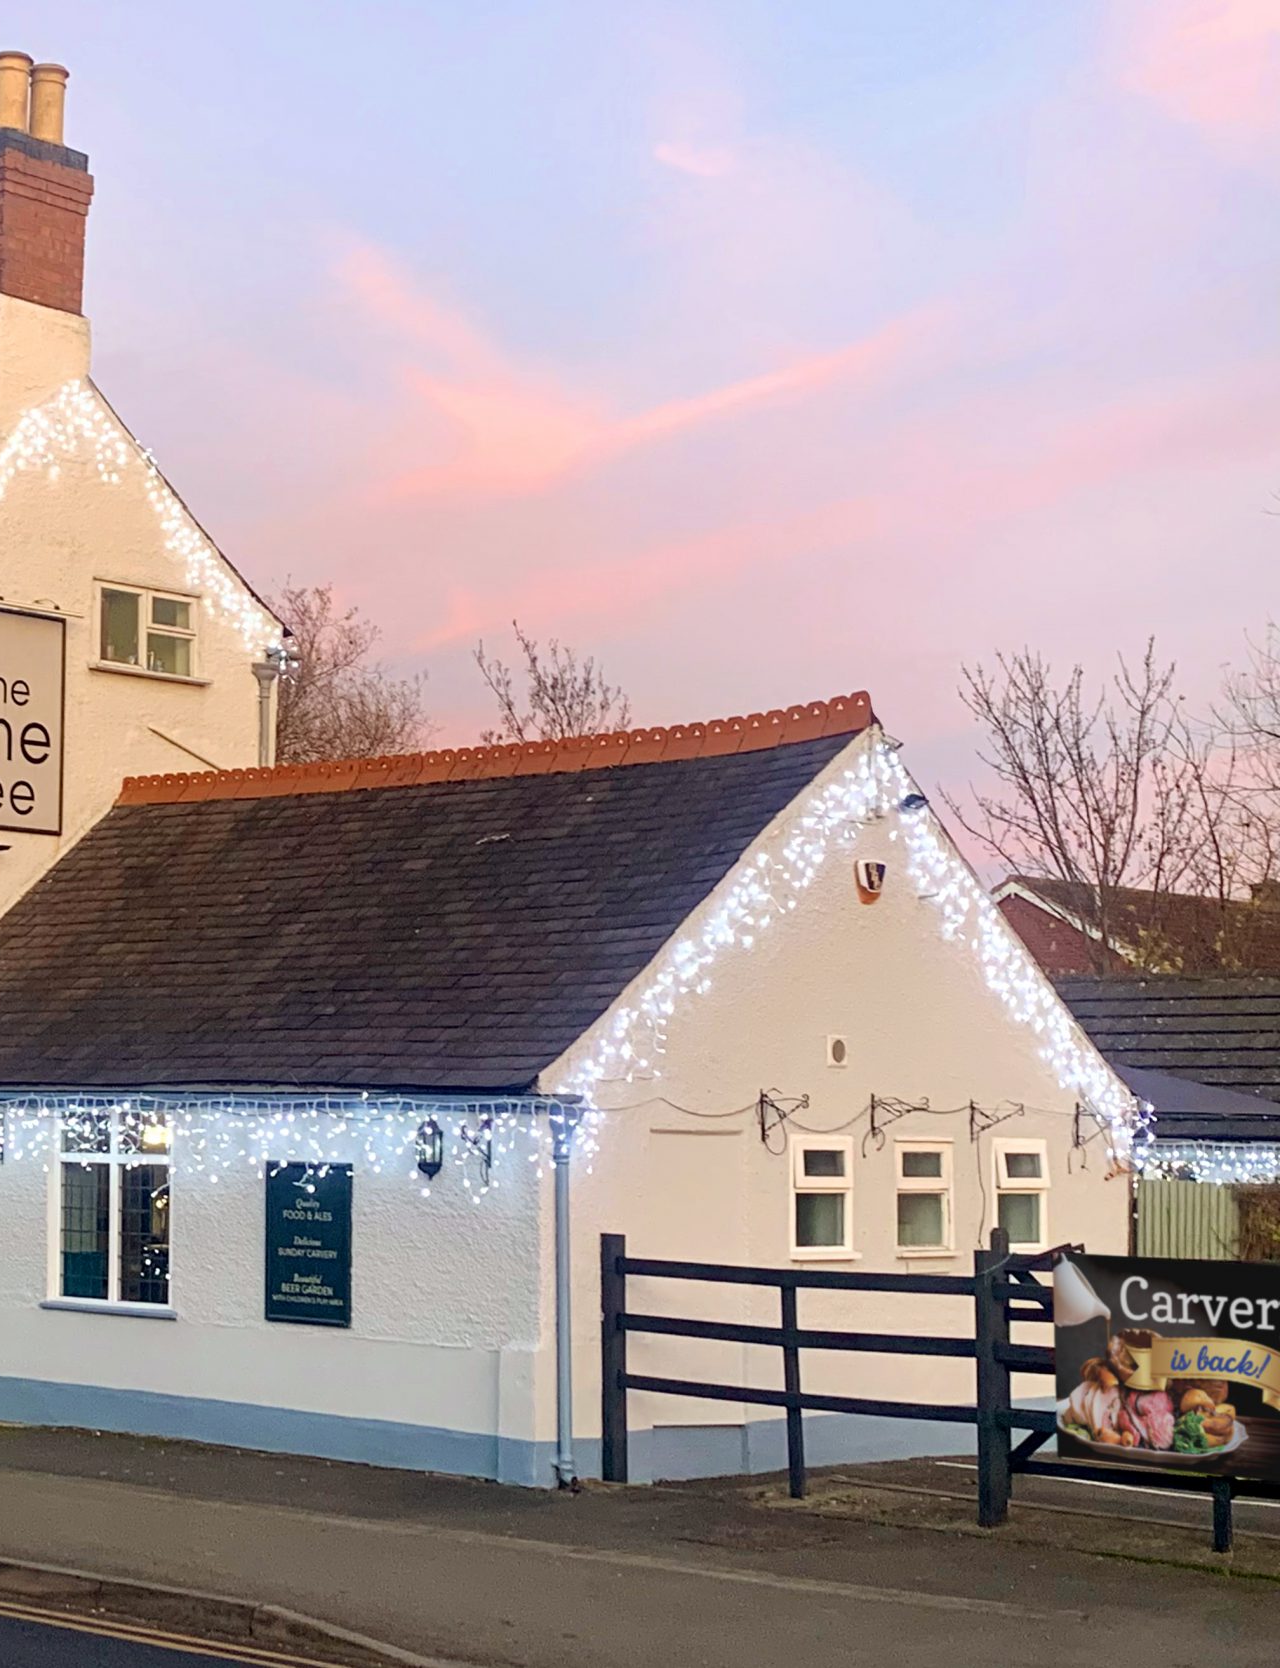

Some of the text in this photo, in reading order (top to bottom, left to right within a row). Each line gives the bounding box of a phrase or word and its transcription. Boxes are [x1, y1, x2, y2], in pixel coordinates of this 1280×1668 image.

[282, 1209, 306, 1220] FOOD
[314, 1211, 333, 1221] ALES
[277, 1247, 306, 1257] SUNDAY
[281, 1282, 334, 1296] BEER GARDEN
[1120, 1275, 1280, 1331] Carver
[1170, 1345, 1272, 1379] is back!
